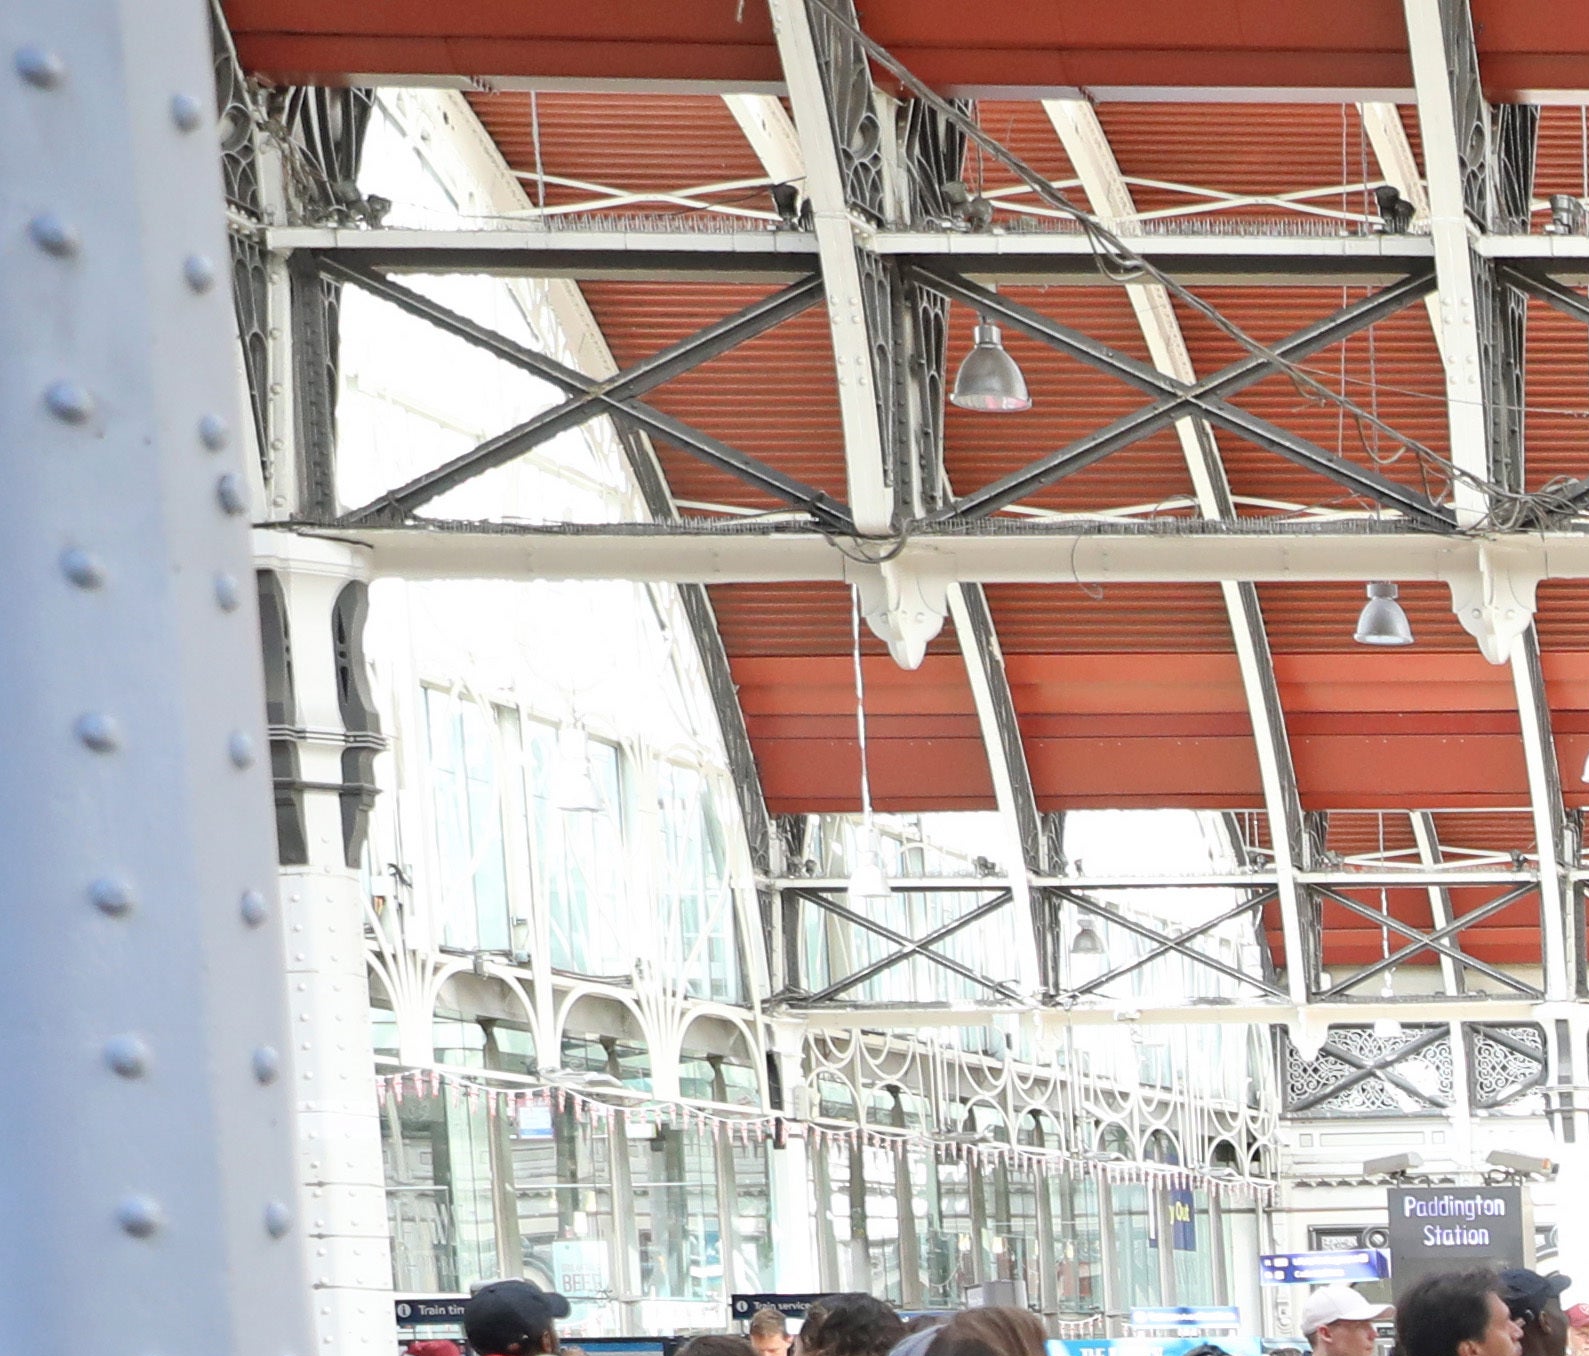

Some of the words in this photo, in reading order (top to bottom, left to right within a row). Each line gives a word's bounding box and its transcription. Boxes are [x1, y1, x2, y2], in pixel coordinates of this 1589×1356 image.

[1403, 1194, 1506, 1220] Paddington
[1423, 1224, 1490, 1247] Station
[418, 1304, 447, 1316] Train
